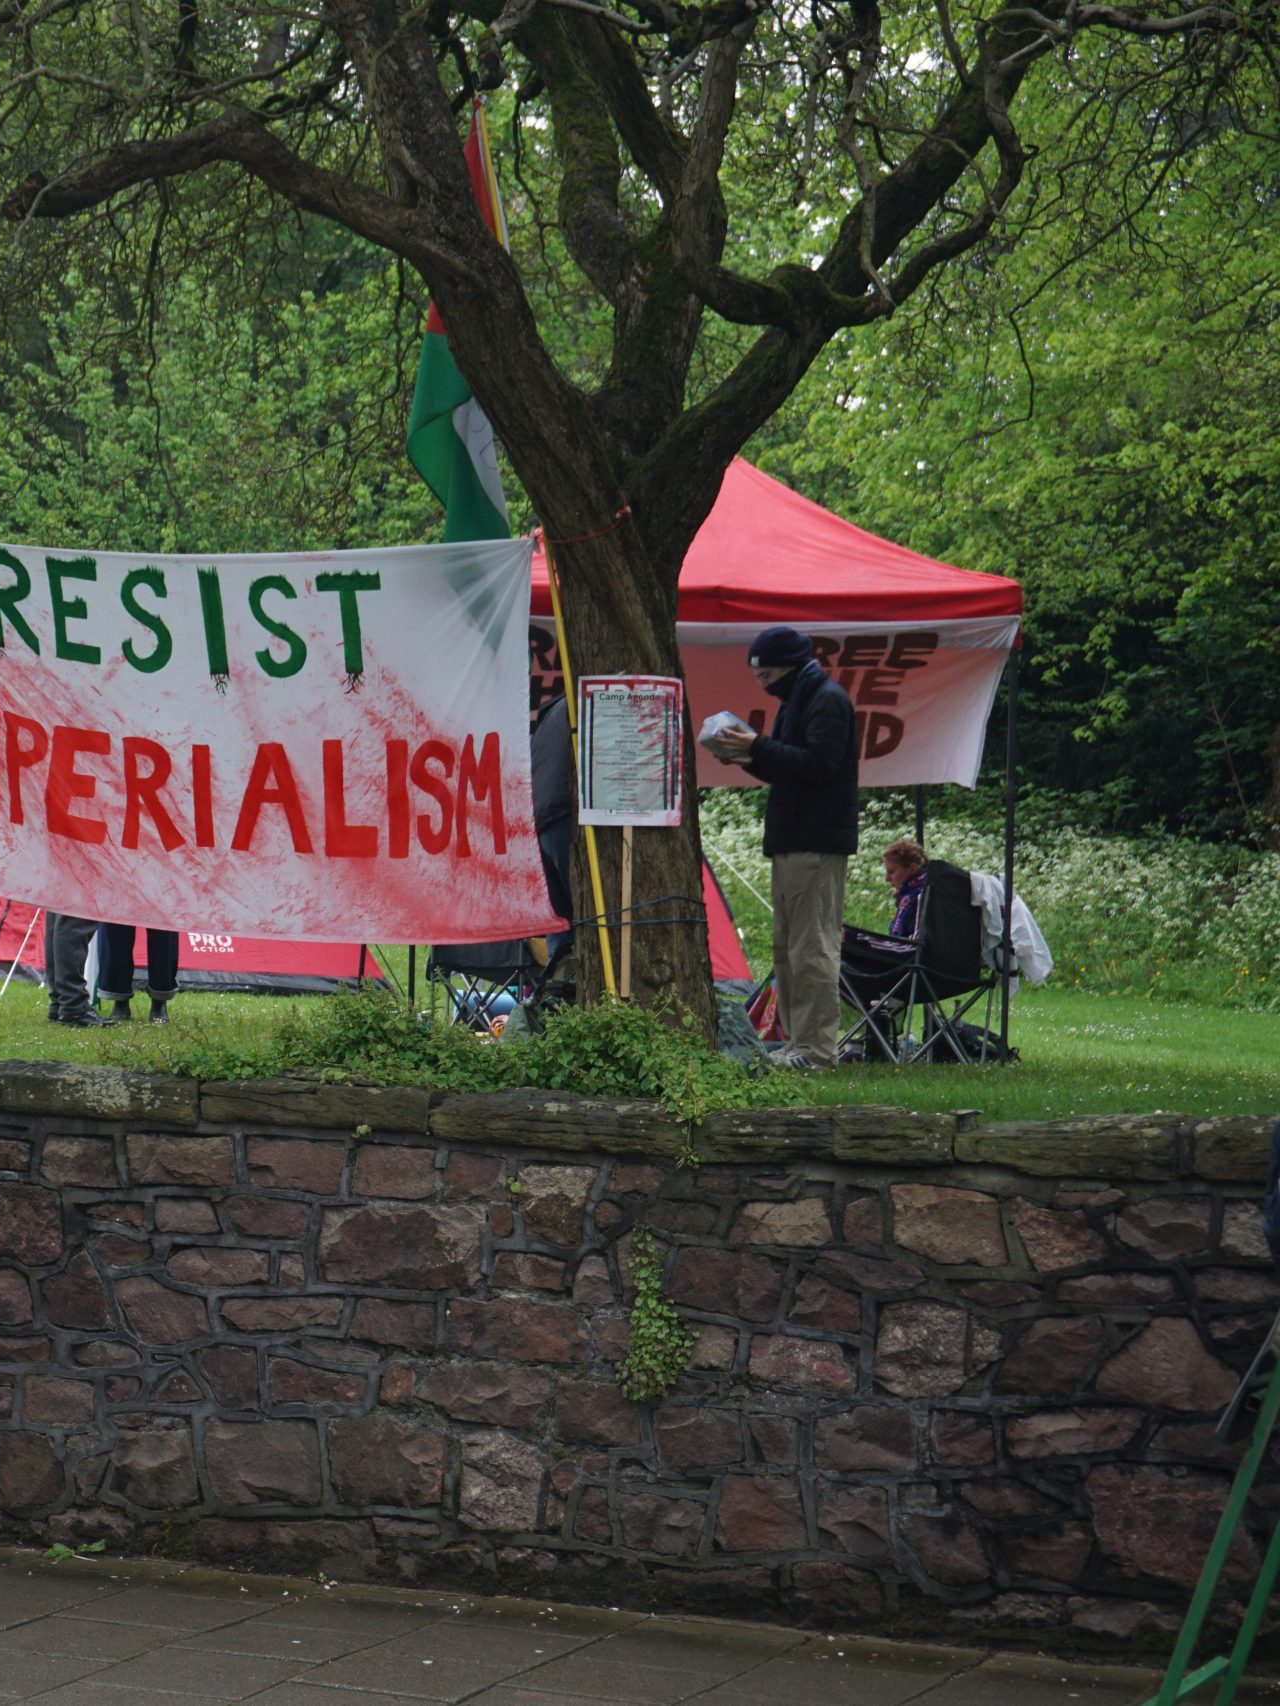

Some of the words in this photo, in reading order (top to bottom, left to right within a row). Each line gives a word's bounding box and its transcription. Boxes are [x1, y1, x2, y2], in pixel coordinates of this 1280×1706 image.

[810, 632, 939, 669] REE
[599, 693, 625, 703] Camp
[188, 932, 233, 946] PRO
